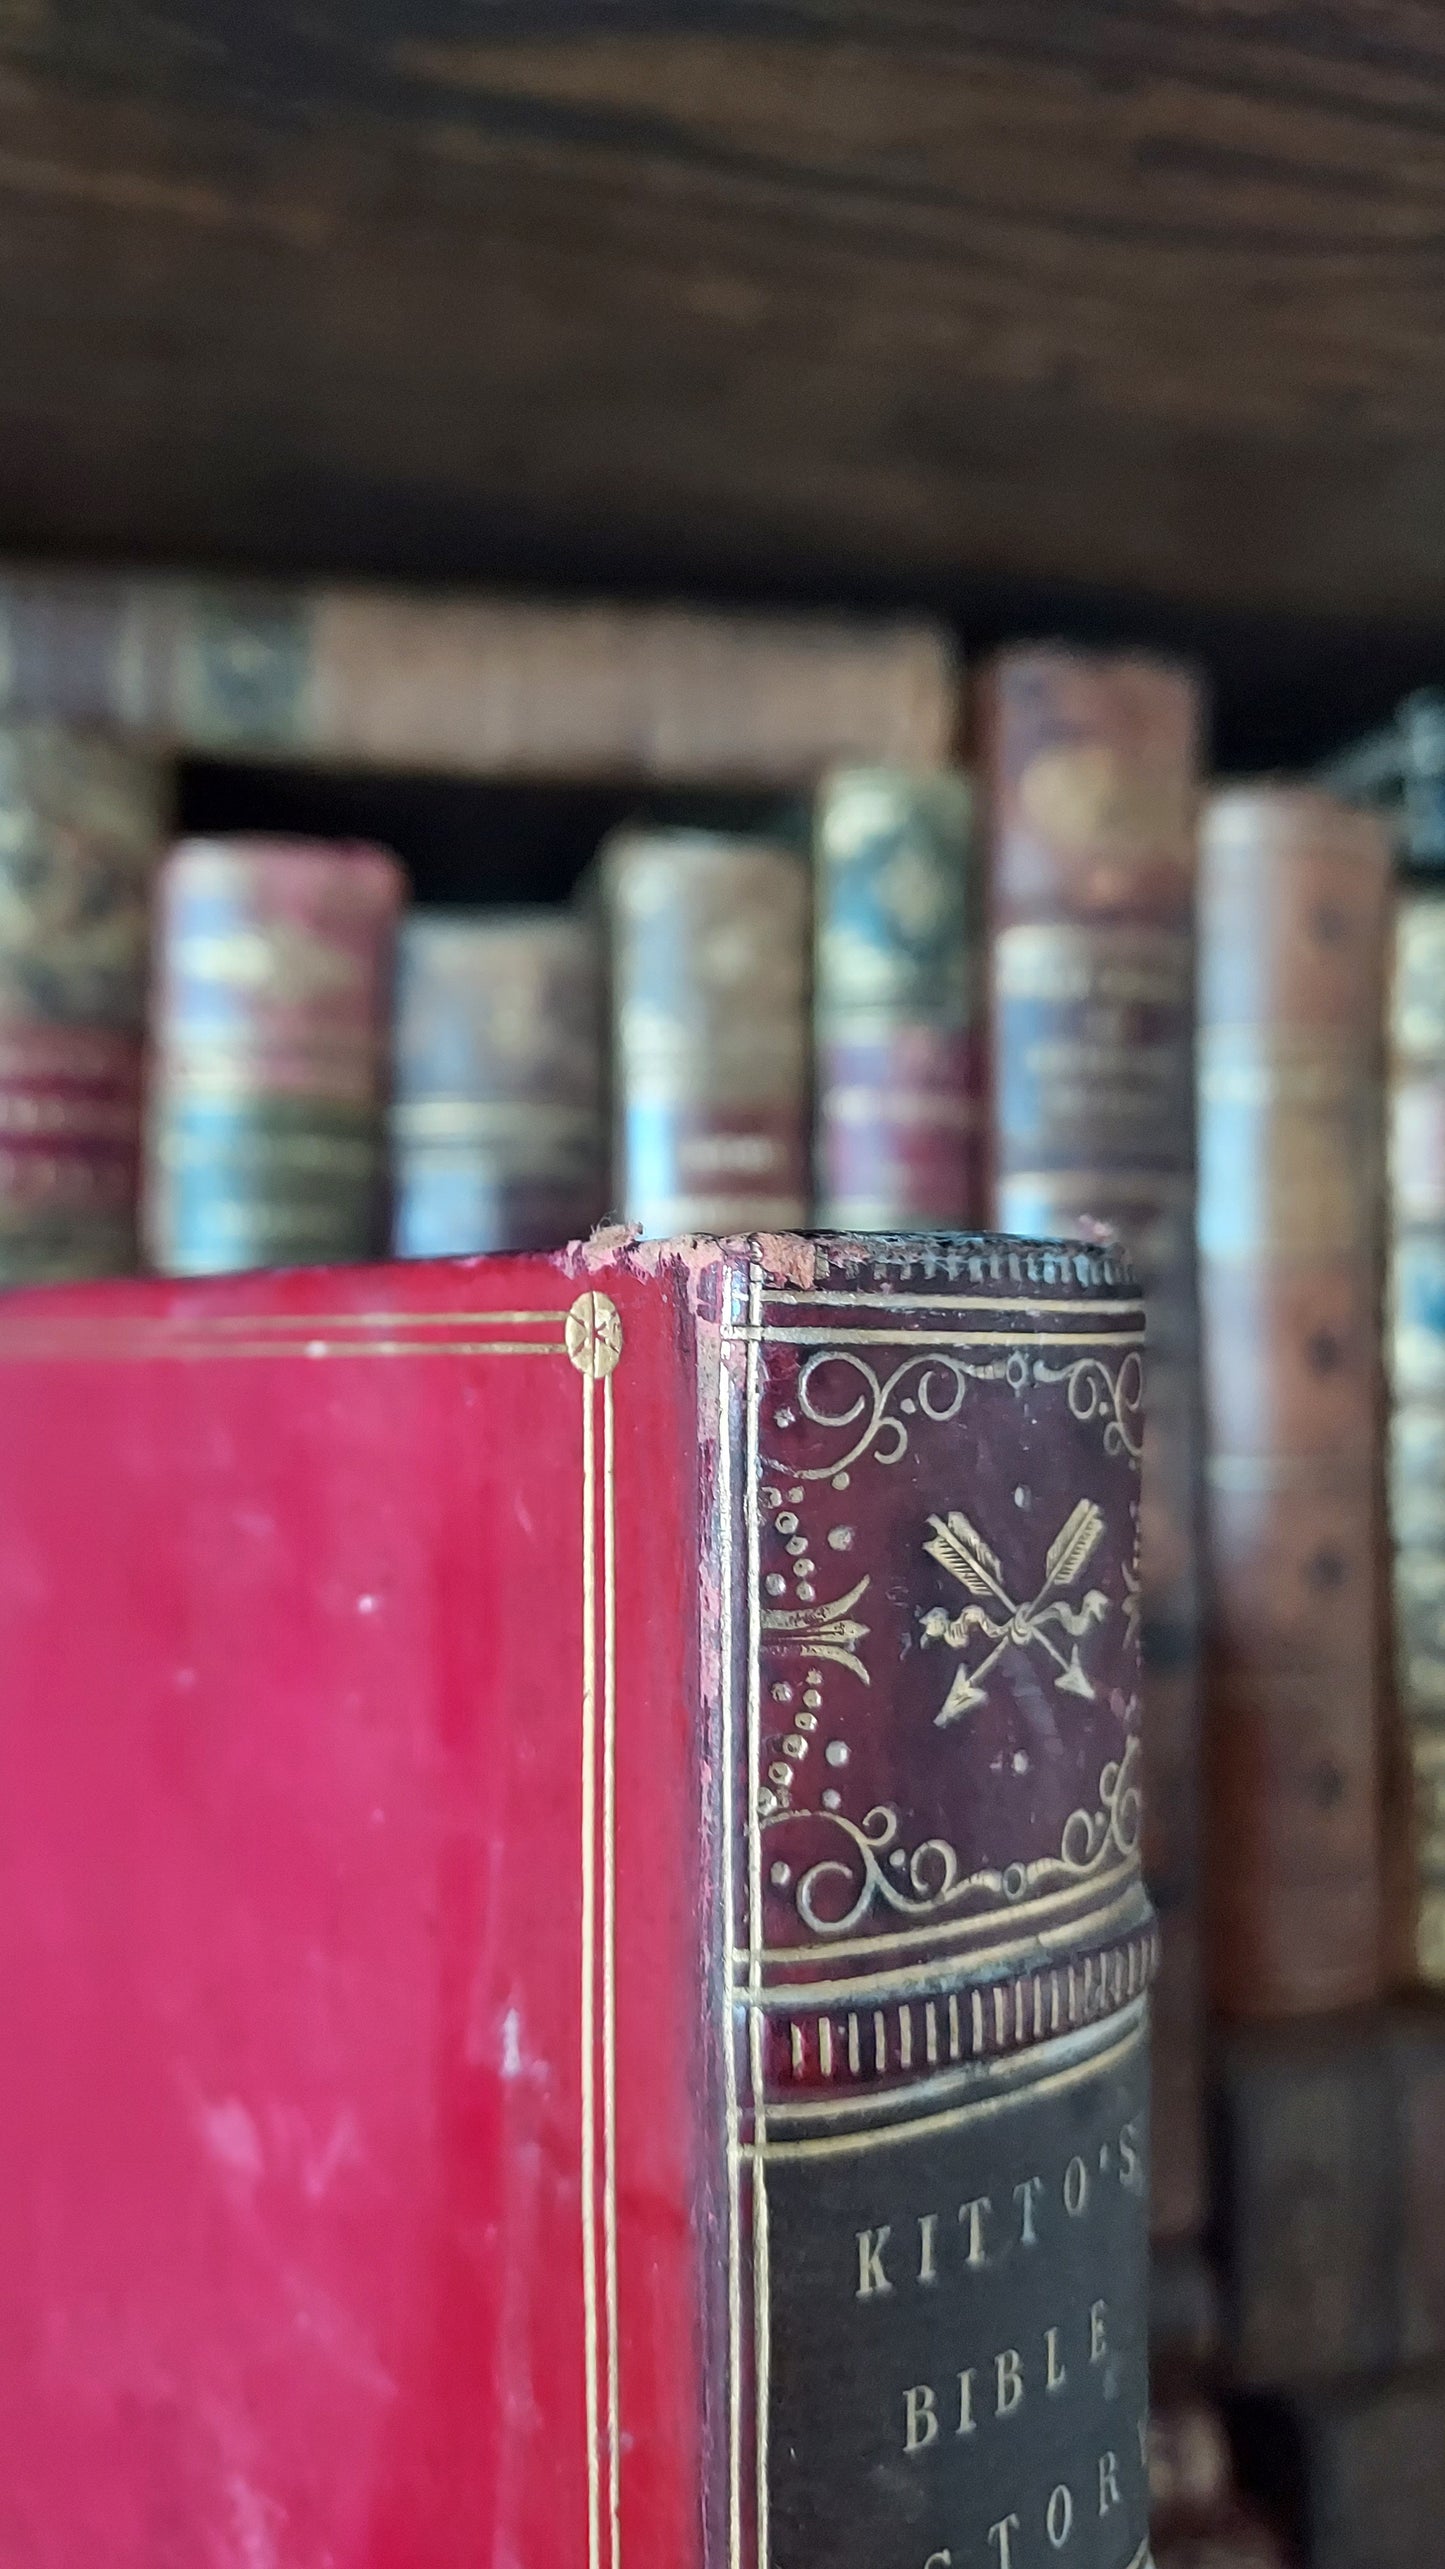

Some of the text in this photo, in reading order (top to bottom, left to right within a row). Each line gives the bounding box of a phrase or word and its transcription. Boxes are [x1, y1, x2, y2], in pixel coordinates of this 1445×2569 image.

[855, 2123, 1145, 2299] KITTO'S
[902, 2299, 1107, 2452] BIBLE
[923, 2417, 1149, 2569] TOR
